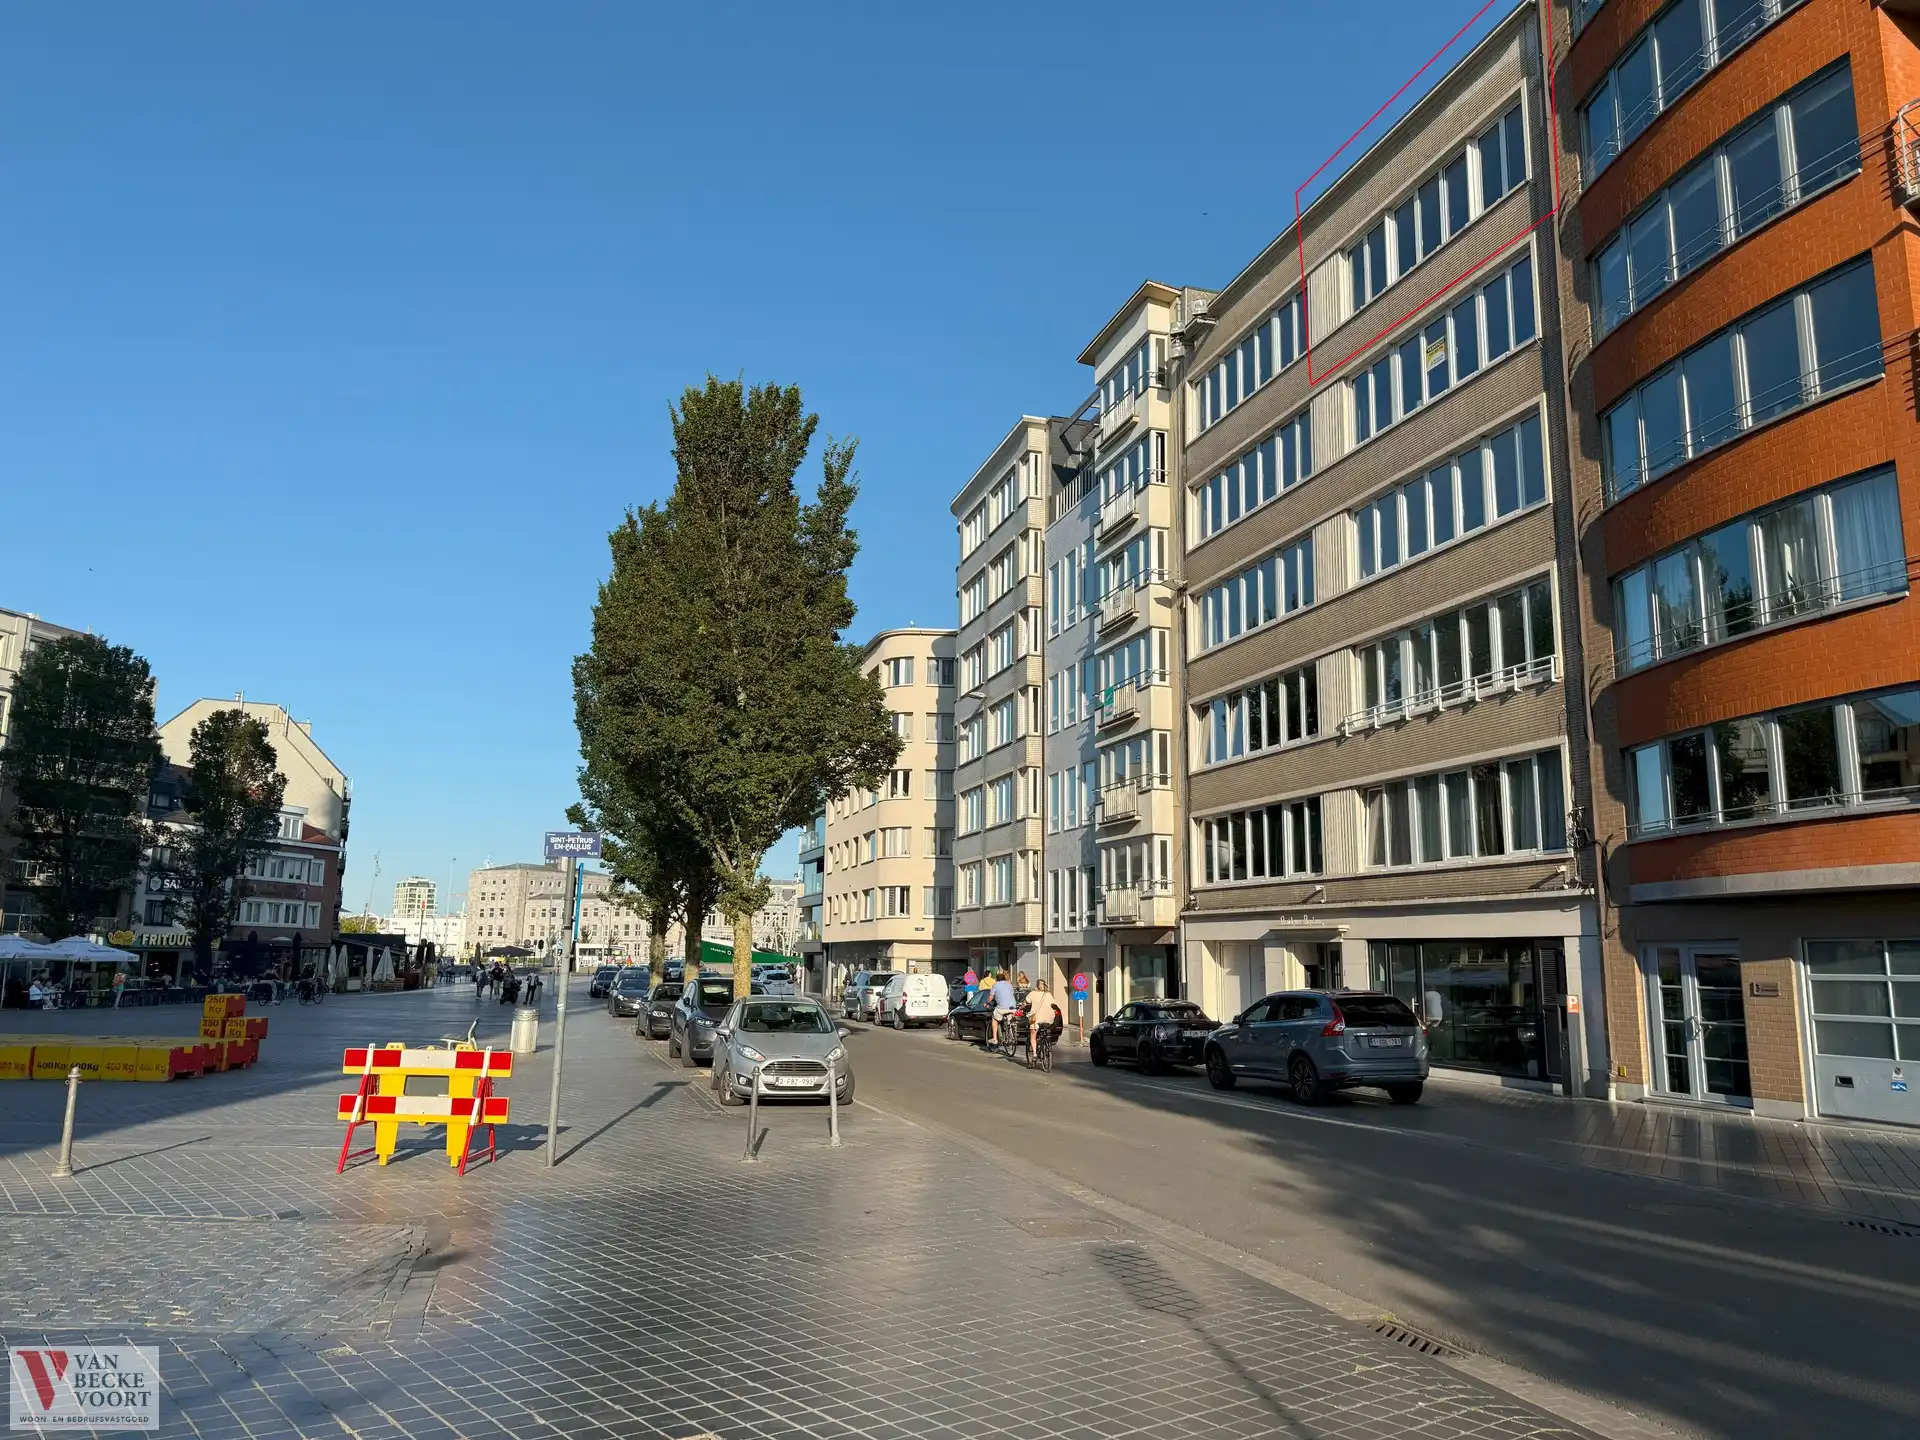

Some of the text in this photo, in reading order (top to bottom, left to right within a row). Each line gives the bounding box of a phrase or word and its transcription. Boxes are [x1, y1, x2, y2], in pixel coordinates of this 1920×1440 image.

[550, 835, 595, 844] SINT-PETRUS-
[553, 843, 592, 851] EN-PAULUS
[207, 995, 225, 1004] 250
[1567, 995, 1578, 1009] P
[208, 1005, 222, 1015] Kg
[202, 1019, 219, 1027] 250
[227, 1019, 245, 1027] 250
[203, 1028, 217, 1037] Kg
[229, 1028, 242, 1037] Kg
[105, 1062, 121, 1071] 400
